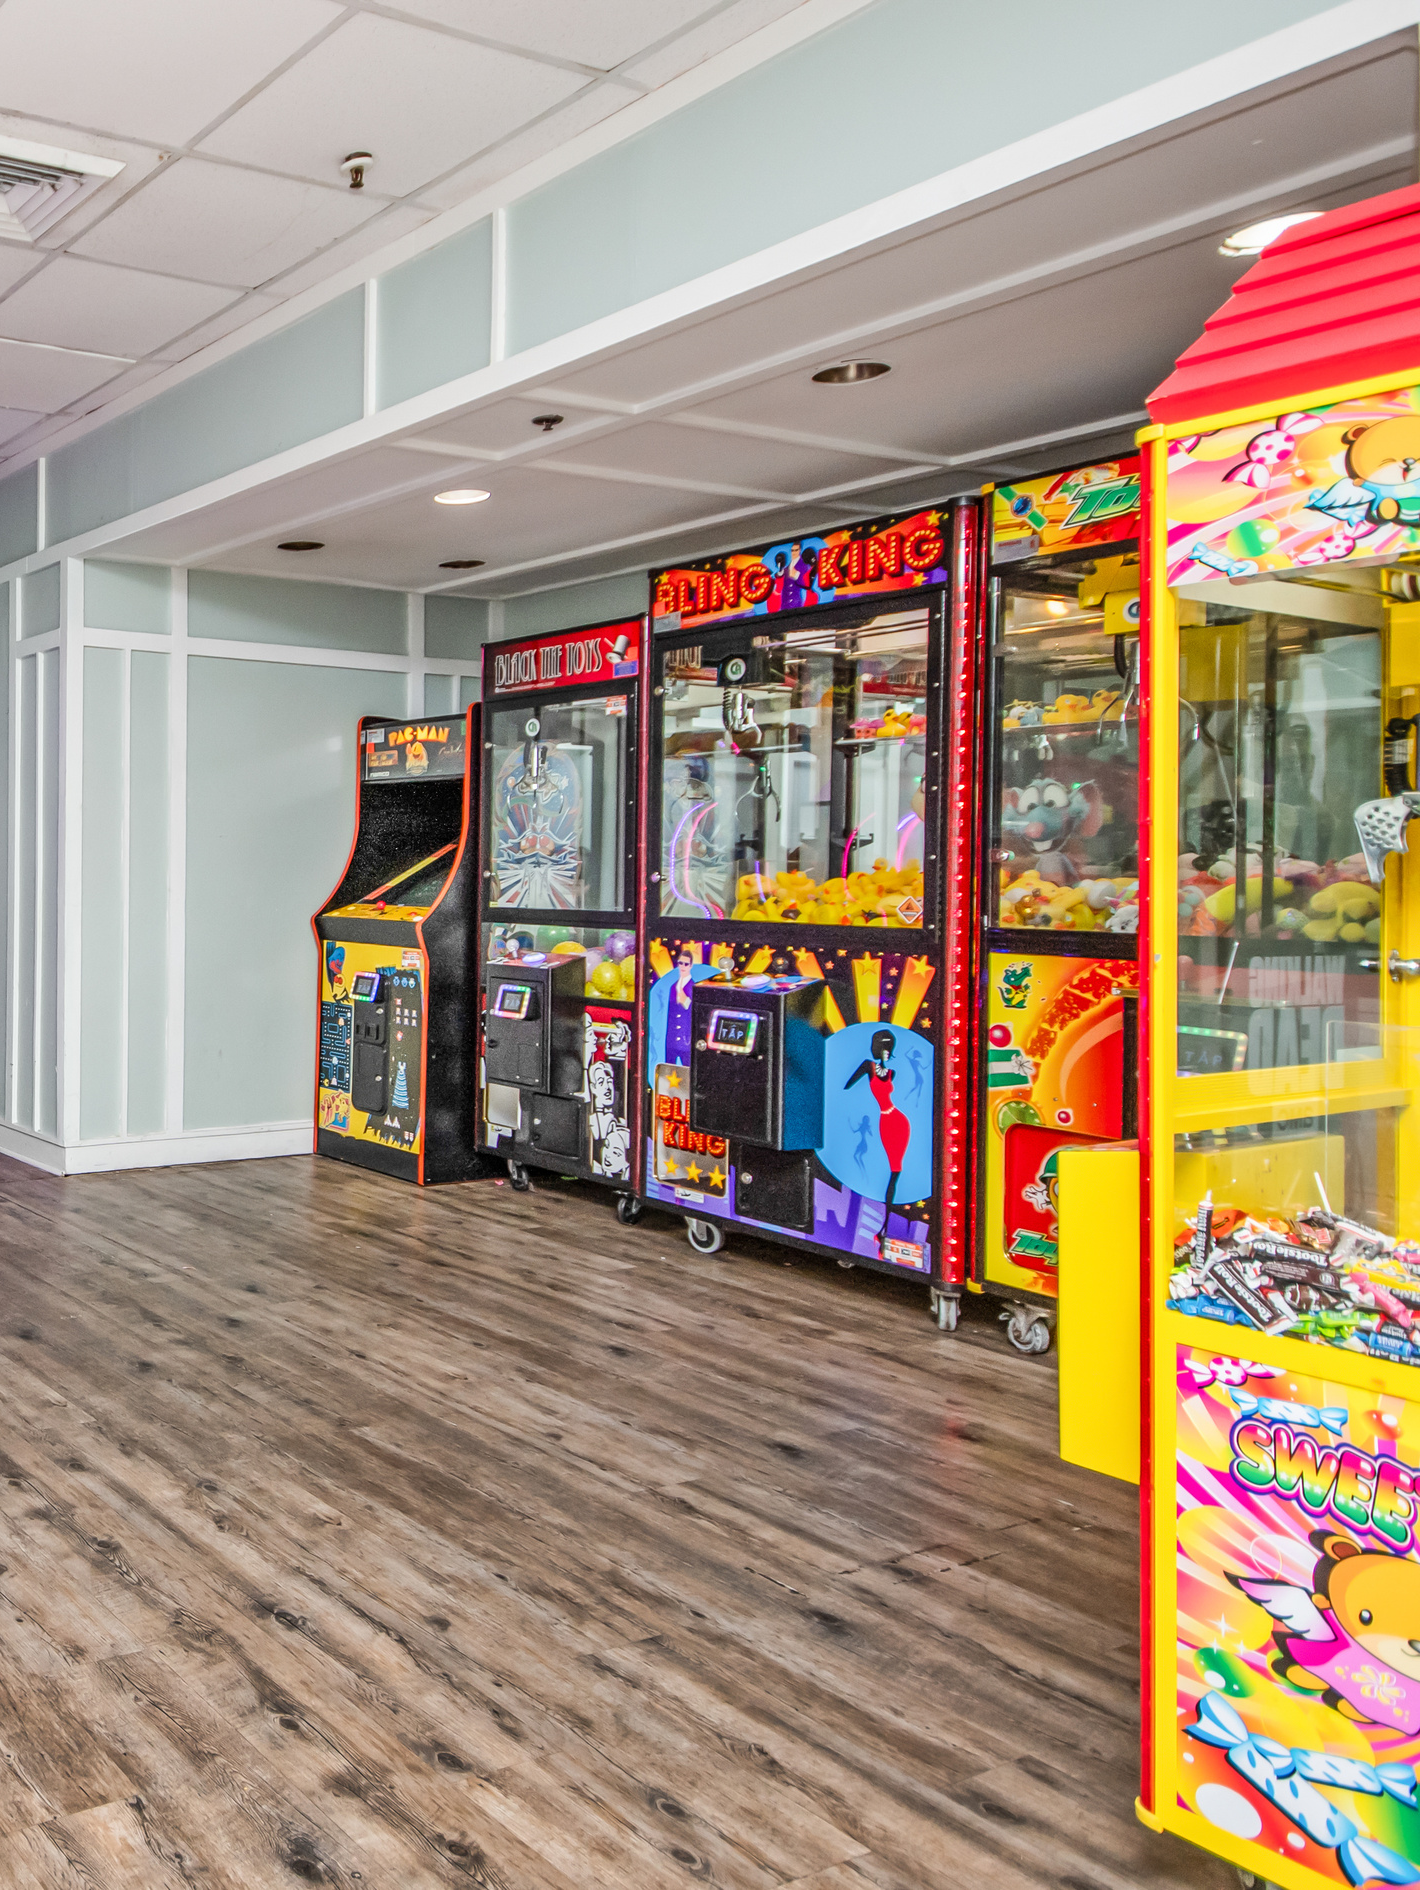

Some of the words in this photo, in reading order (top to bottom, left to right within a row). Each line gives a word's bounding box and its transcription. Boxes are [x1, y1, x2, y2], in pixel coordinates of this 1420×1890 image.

[818, 525, 945, 591] KING
[656, 563, 773, 615] BLING
[495, 649, 537, 686] BLACK
[540, 645, 562, 679] TIE
[565, 638, 603, 676] TOYS
[388, 725, 451, 747] PAC-MAN
[663, 1121, 729, 1158] KING
[1228, 1416, 1420, 1552] SWEE
